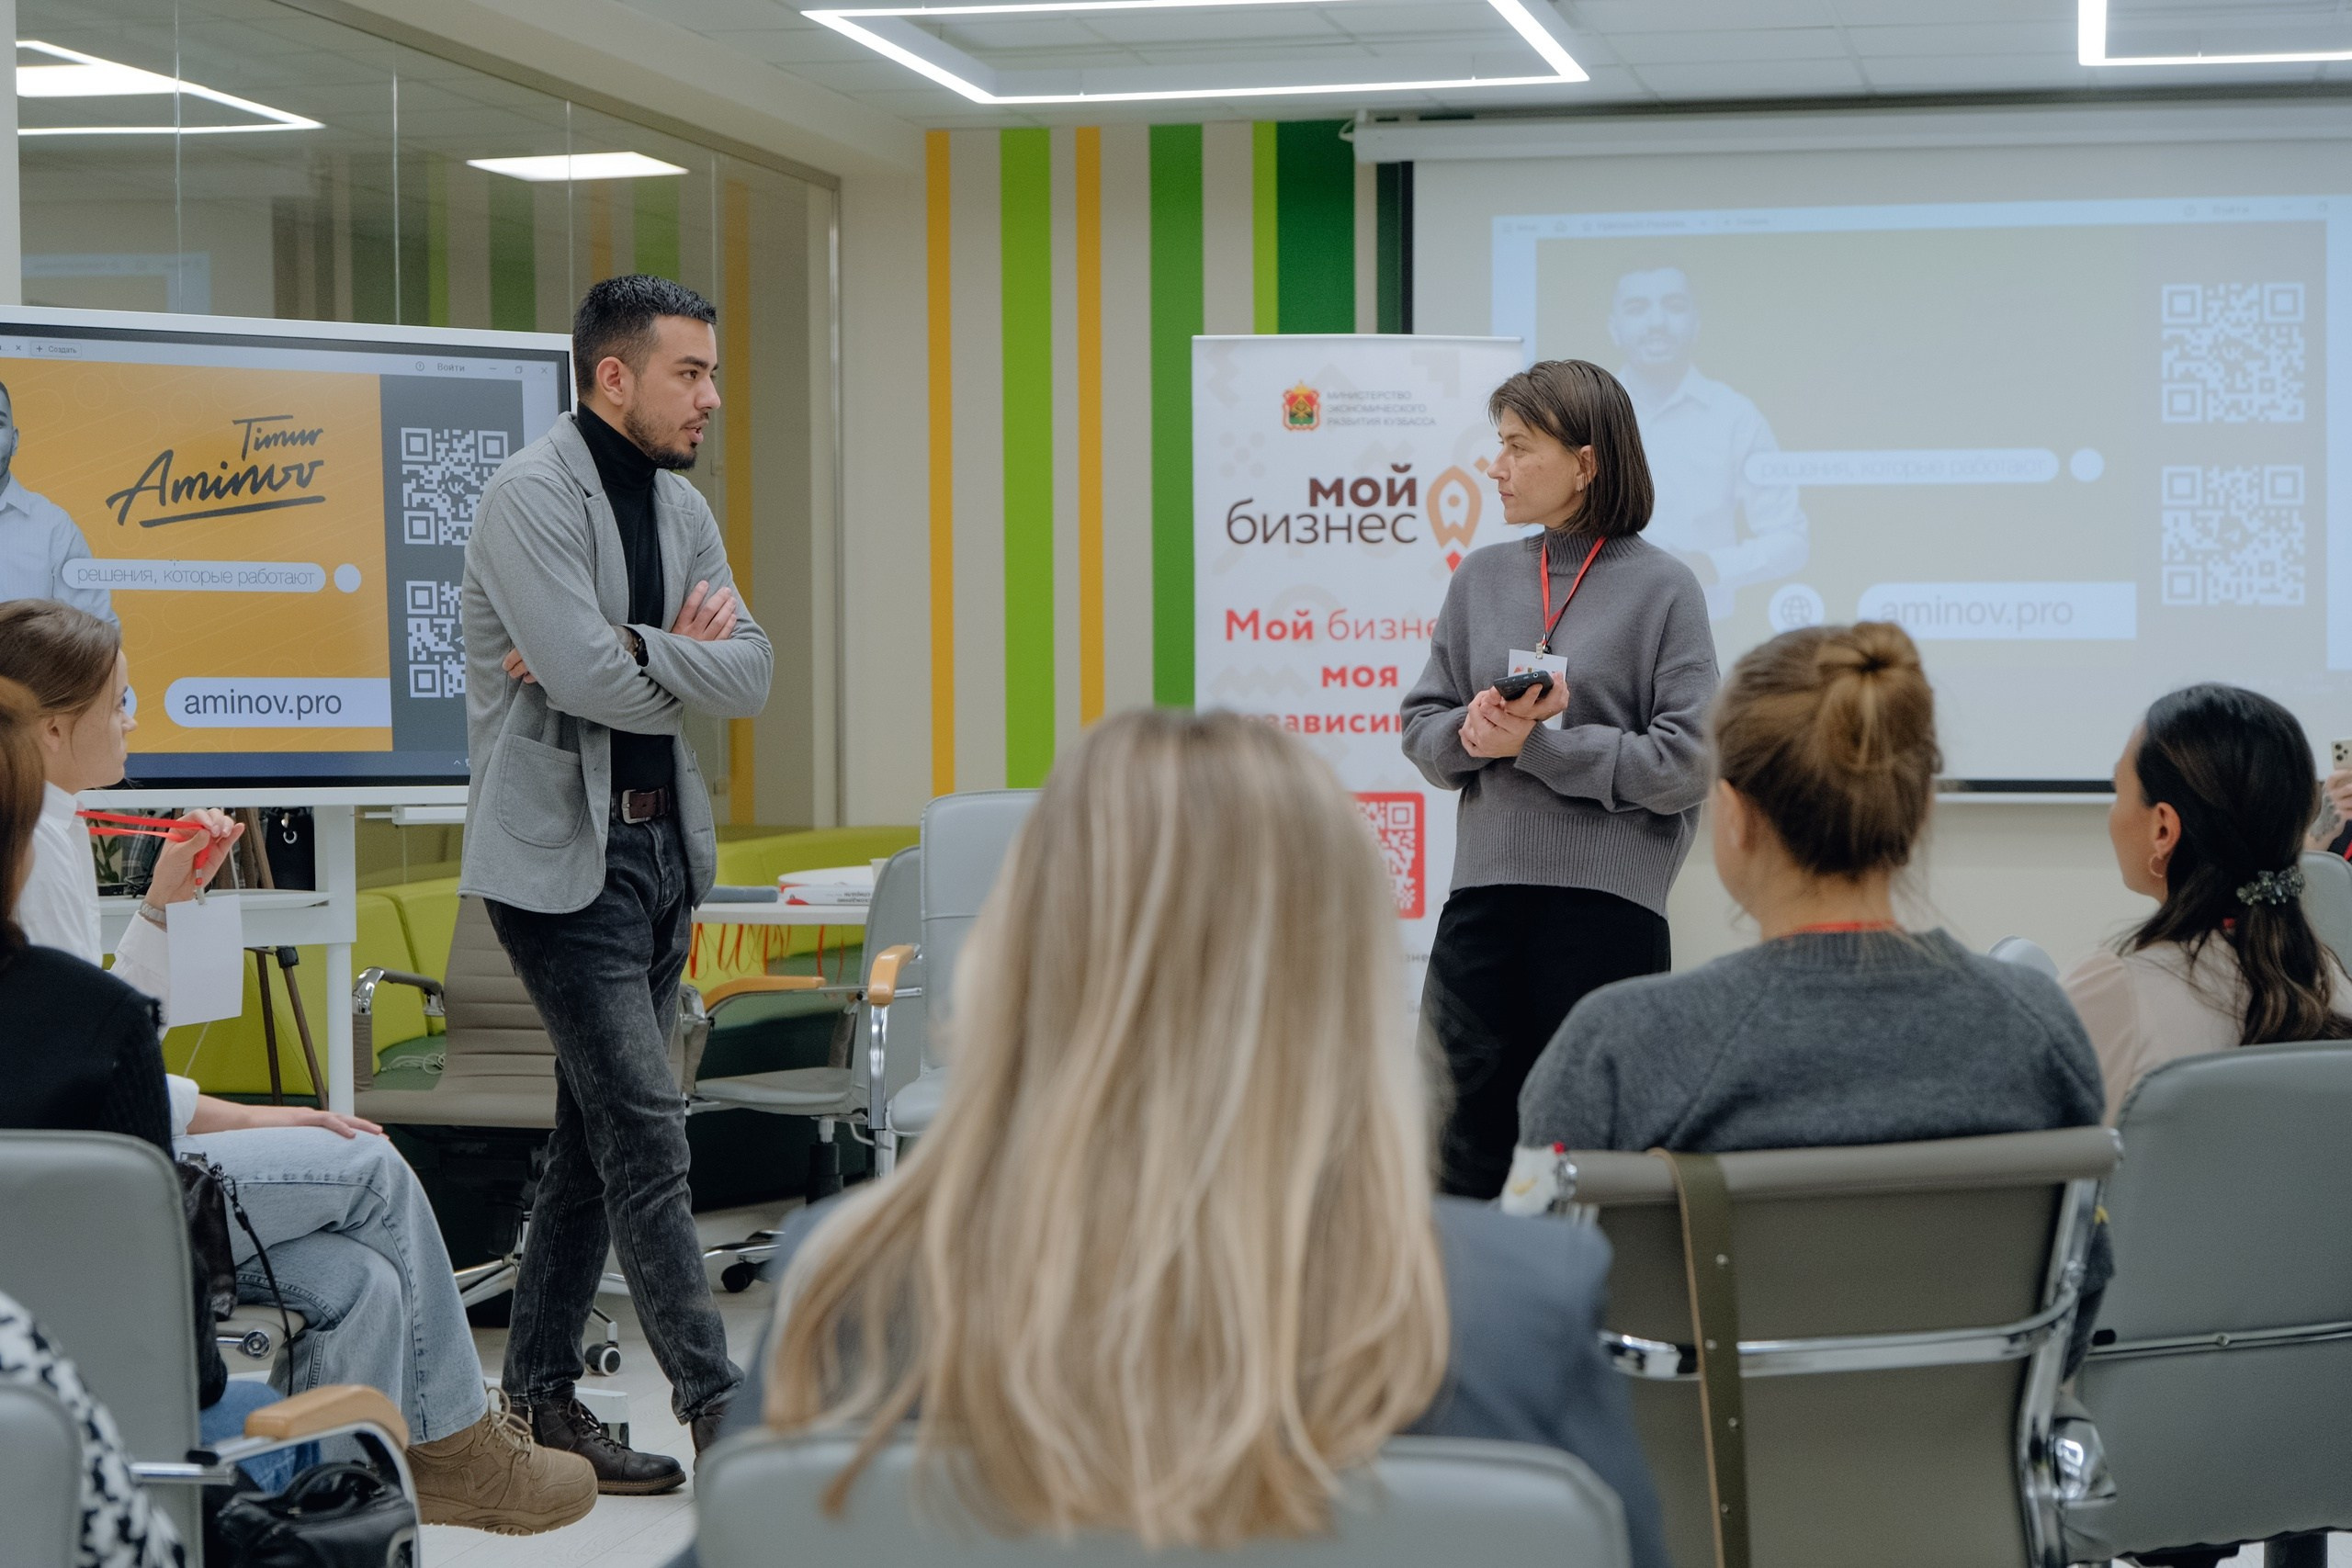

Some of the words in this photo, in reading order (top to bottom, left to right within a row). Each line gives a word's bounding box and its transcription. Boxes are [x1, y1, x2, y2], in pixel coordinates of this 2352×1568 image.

[48, 344, 77, 355] Создать
[436, 362, 466, 373] Войти
[1327, 390, 1412, 400] МИНИСТЕРСТВО
[232, 413, 324, 461] Timur
[106, 448, 325, 526] Aminov
[1308, 463, 1418, 508] мой
[1227, 498, 1419, 546] бизнес
[77, 567, 157, 584] решения,
[164, 570, 232, 587] которые
[238, 568, 315, 587] работают
[1226, 608, 1314, 641] Мой
[1883, 595, 2074, 631] aminov.pro
[1321, 665, 1398, 688] моя
[184, 689, 343, 721] aminov.pro
